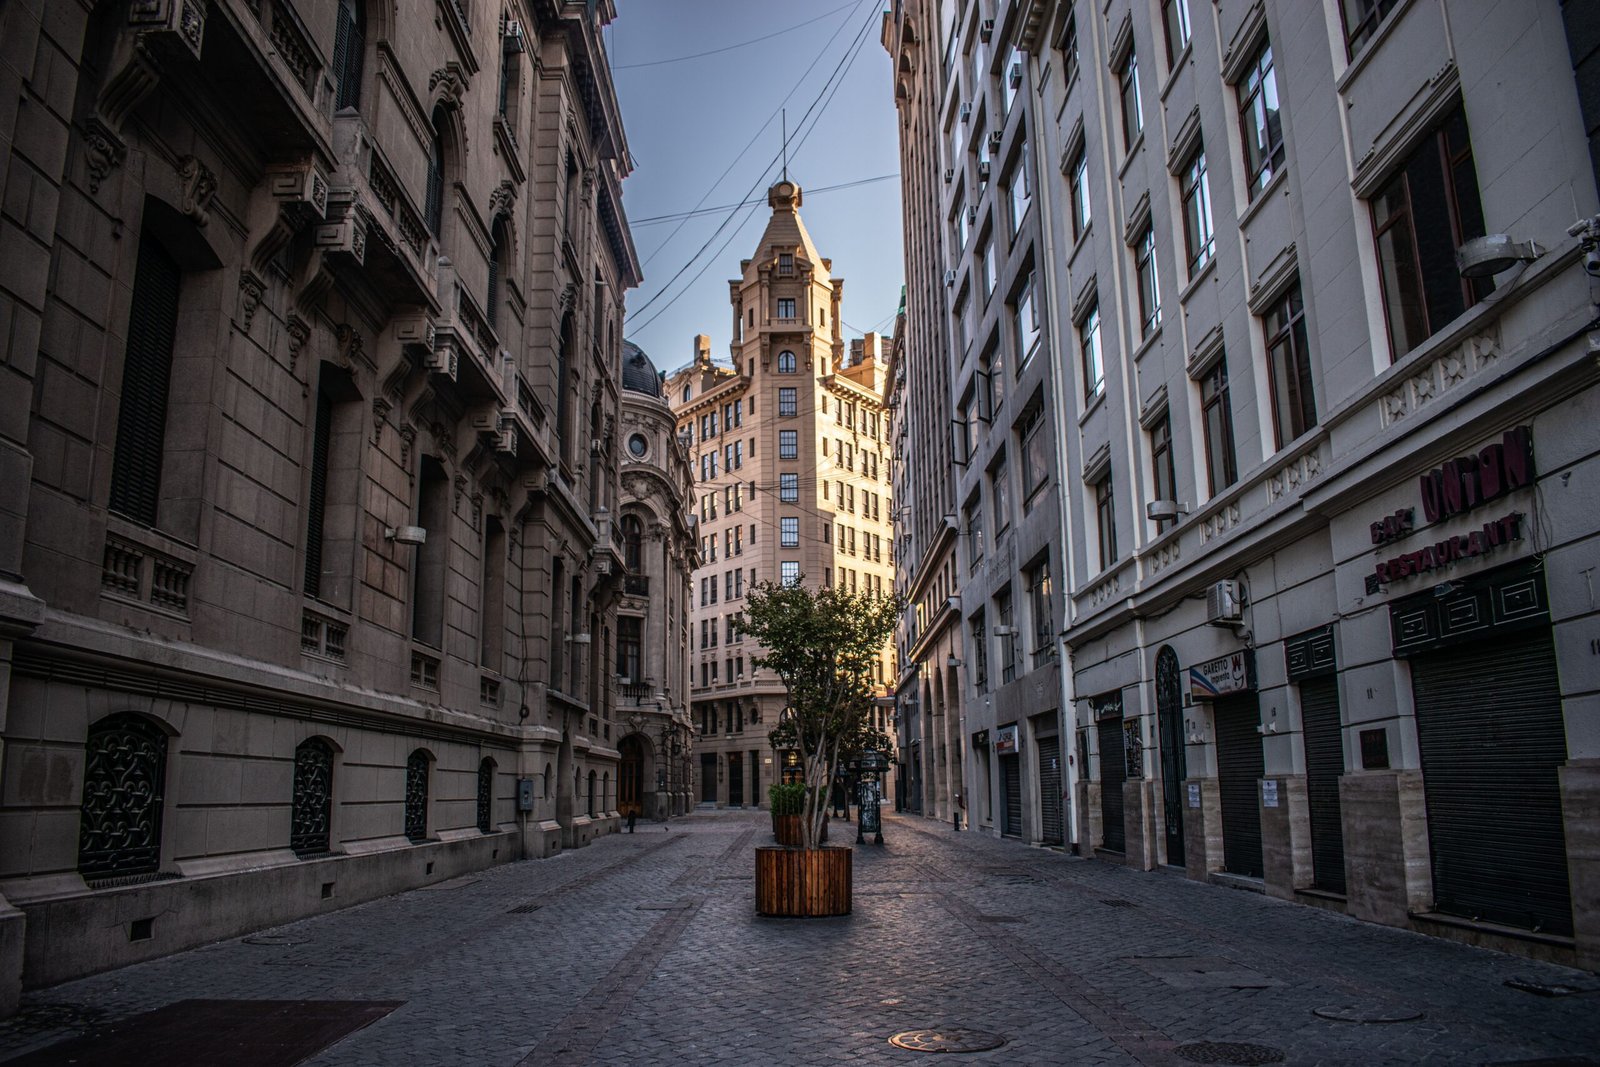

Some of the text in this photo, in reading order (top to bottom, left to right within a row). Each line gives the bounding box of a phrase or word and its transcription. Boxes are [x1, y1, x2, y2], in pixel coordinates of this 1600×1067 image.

[1370, 507, 1413, 544] BAR
[1376, 513, 1518, 583] RESTAURANT
[1203, 659, 1228, 676] GARETTO
